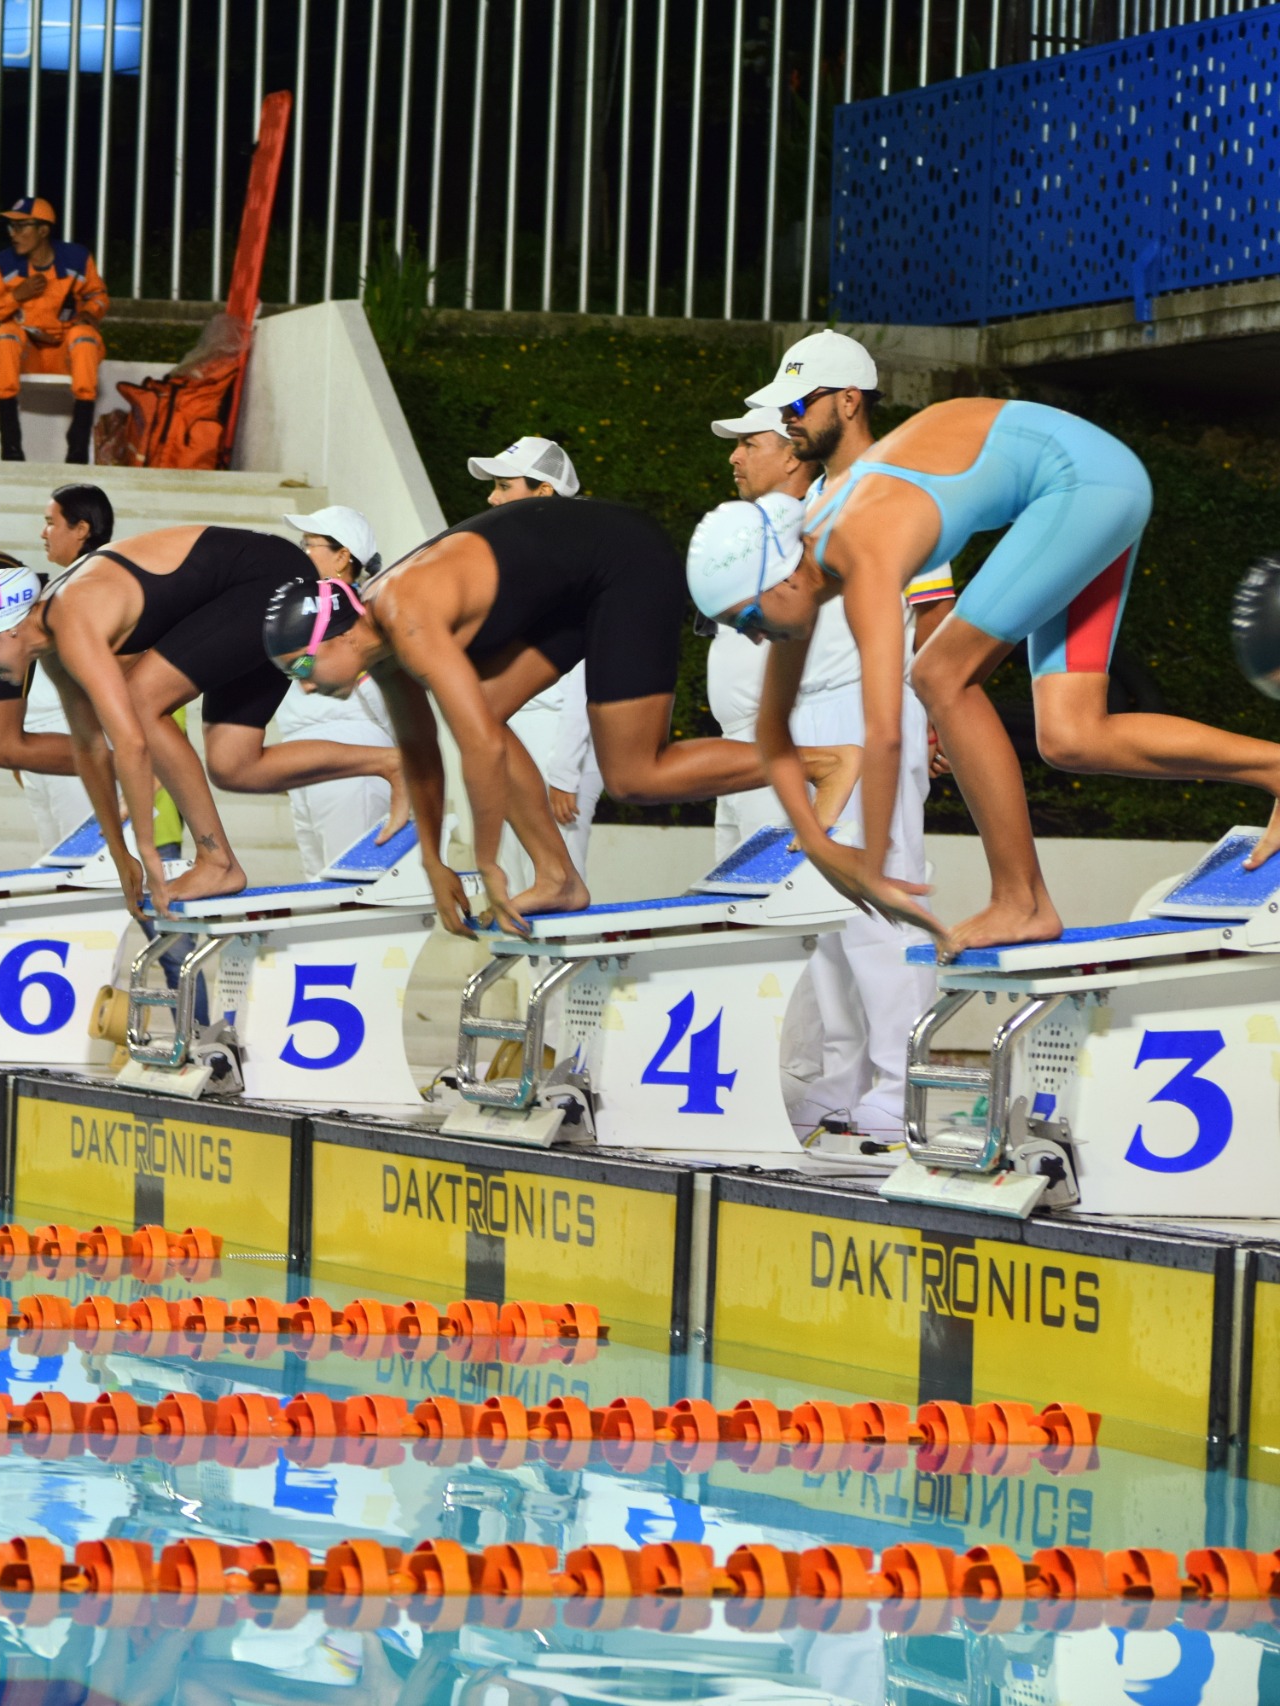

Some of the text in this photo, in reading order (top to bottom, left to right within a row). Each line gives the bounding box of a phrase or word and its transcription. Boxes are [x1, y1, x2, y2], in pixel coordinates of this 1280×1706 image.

[301, 593, 340, 615] AT
[279, 963, 365, 1070] 5
[641, 991, 737, 1115] 4
[72, 1115, 232, 1184] DAKTRONICS
[1124, 1029, 1233, 1173] 3
[382, 1165, 596, 1246] DAKTRONICS
[811, 1232, 1100, 1333] DAKTRONICS
